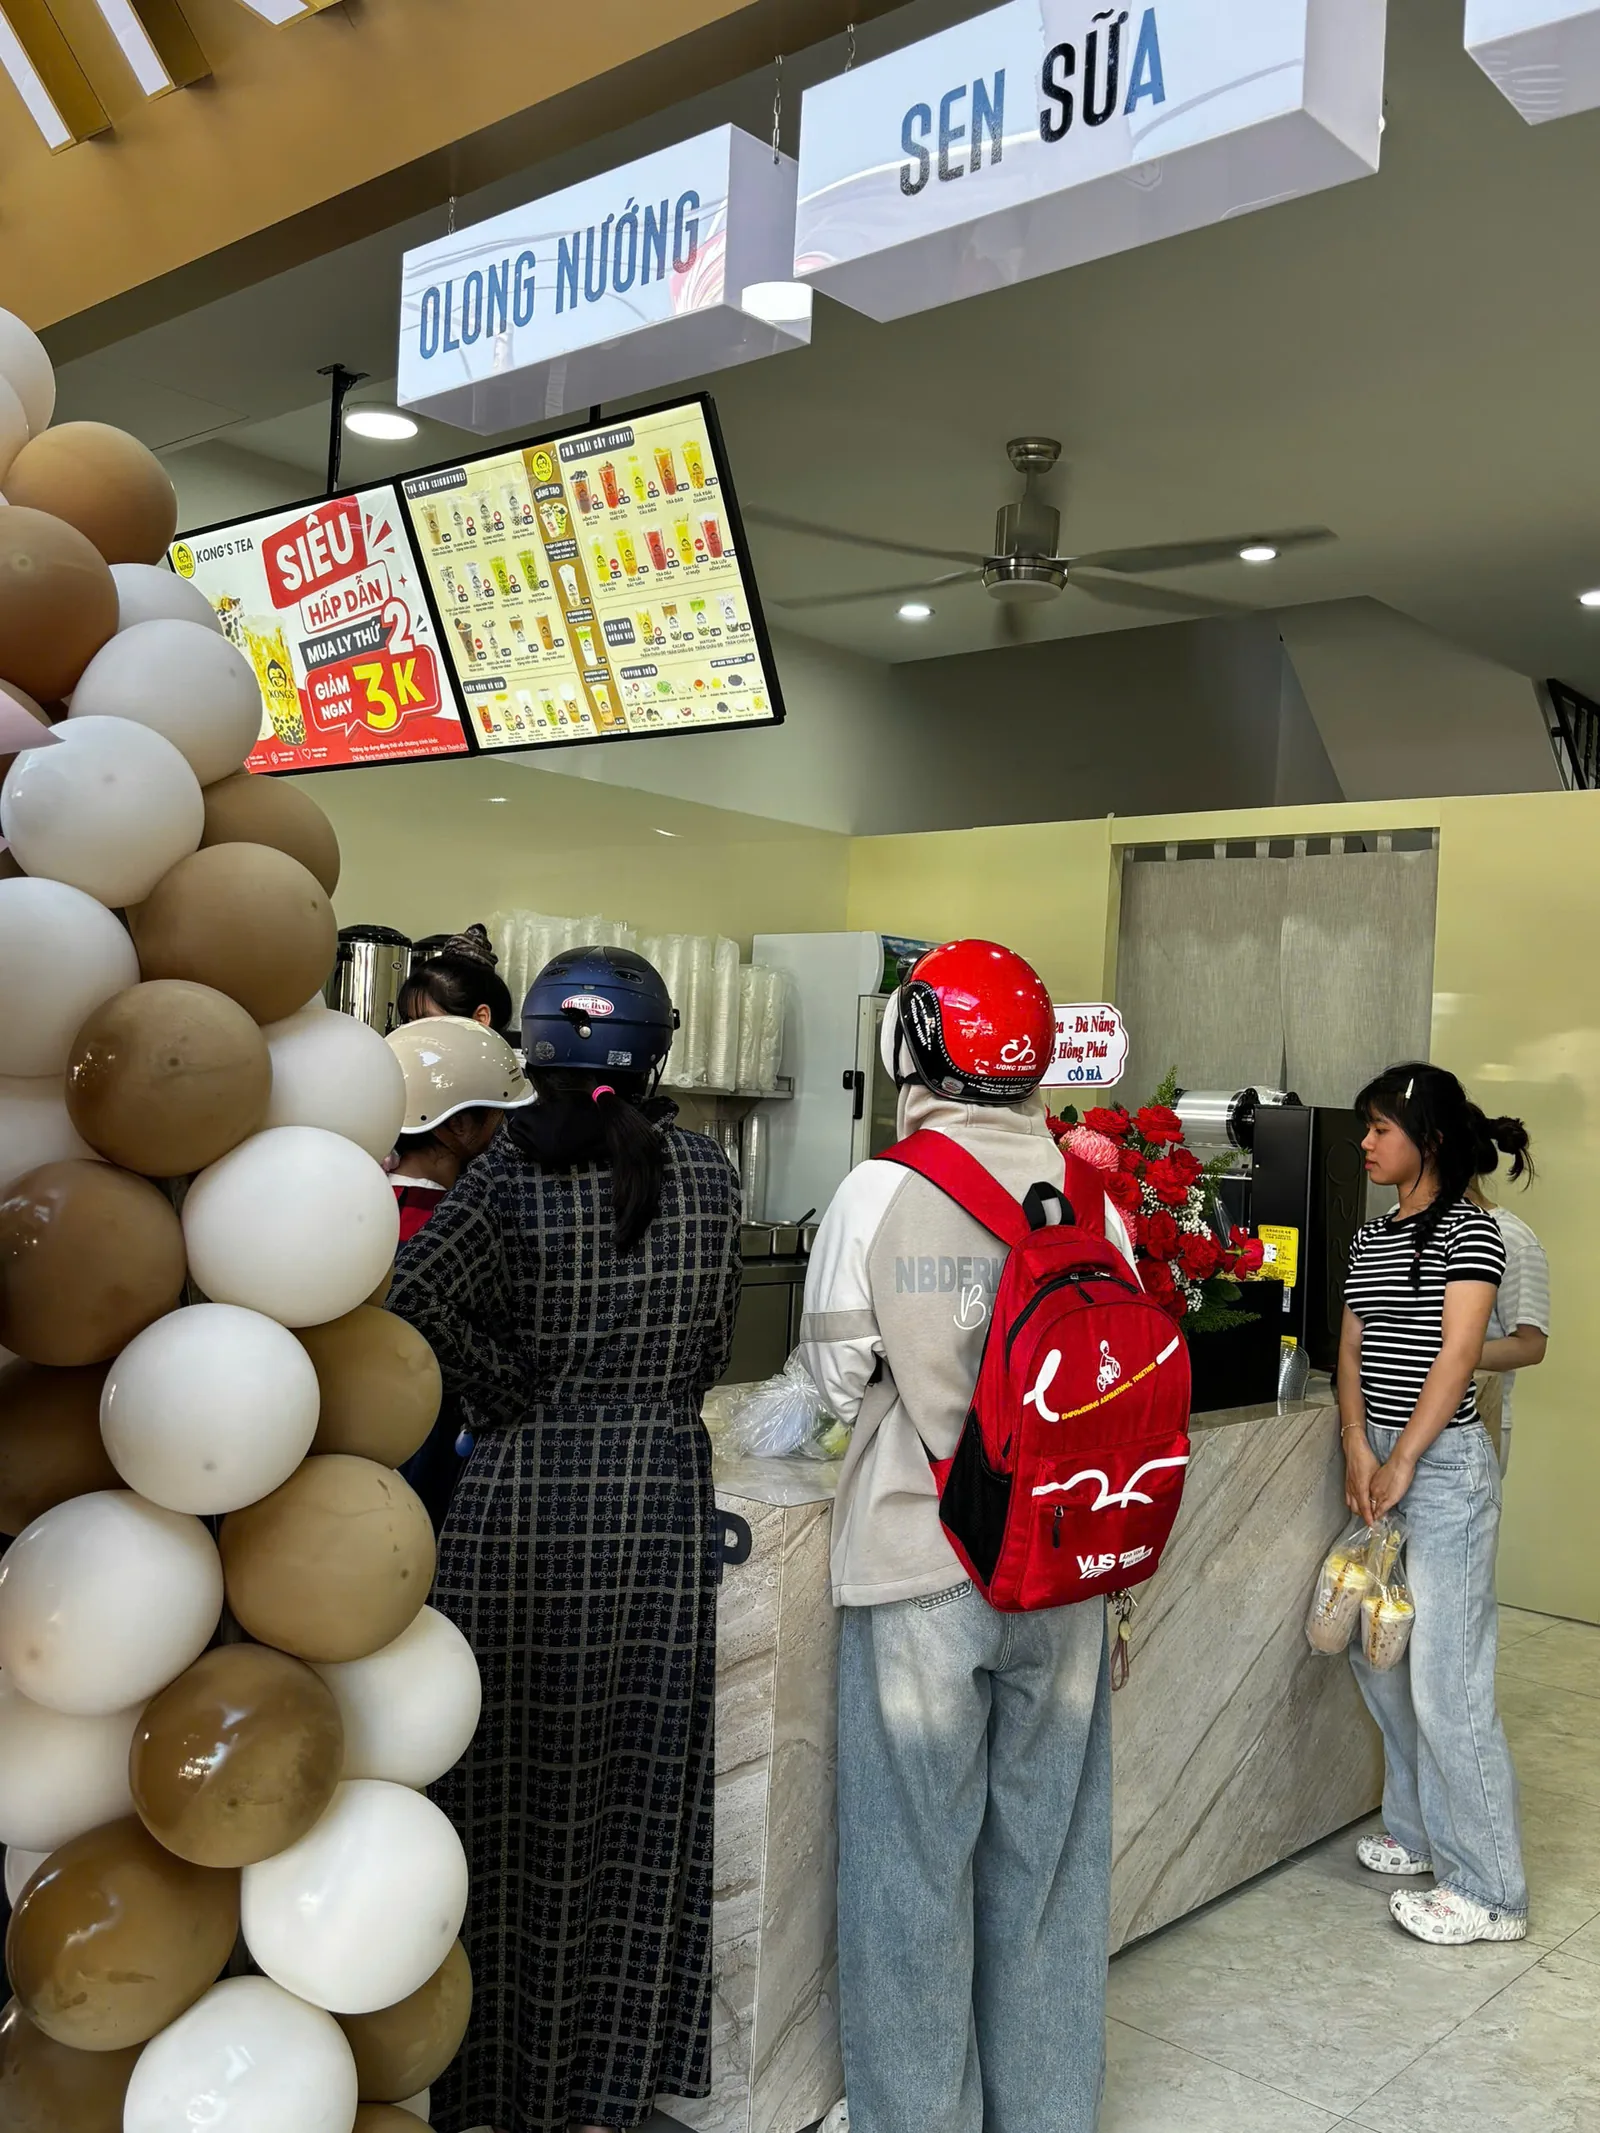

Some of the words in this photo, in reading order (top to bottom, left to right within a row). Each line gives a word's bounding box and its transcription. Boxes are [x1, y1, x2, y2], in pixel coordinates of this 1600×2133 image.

[899, 69, 1006, 197] SEN
[1038, 7, 1167, 144] SỮA
[419, 252, 536, 360] OLONG
[555, 188, 702, 315] NƯỚNG
[196, 542, 234, 563] KONG'S
[235, 538, 254, 553] TEA
[276, 512, 354, 592] SIÊU
[308, 590, 341, 626] HẤP
[344, 574, 383, 611] DẪN
[307, 641, 336, 664] MUA
[336, 633, 353, 654] LY
[355, 622, 382, 648] THỨ
[381, 598, 413, 655] 2
[315, 674, 350, 700] GIẢM
[321, 699, 353, 721] NGAY
[1075, 1016, 1088, 1033] Đà
[1090, 1011, 1115, 1036] Nẵng
[1058, 1037, 1084, 1063] Hồng
[1085, 1040, 1108, 1058] Phát
[1068, 1066, 1084, 1081] CÔ
[1085, 1065, 1103, 1080] HÀ
[1061, 1400, 1100, 1420] EMPOWERING
[1132, 1361, 1156, 1383] TOGETHER
[1076, 1553, 1116, 1574] VUS
